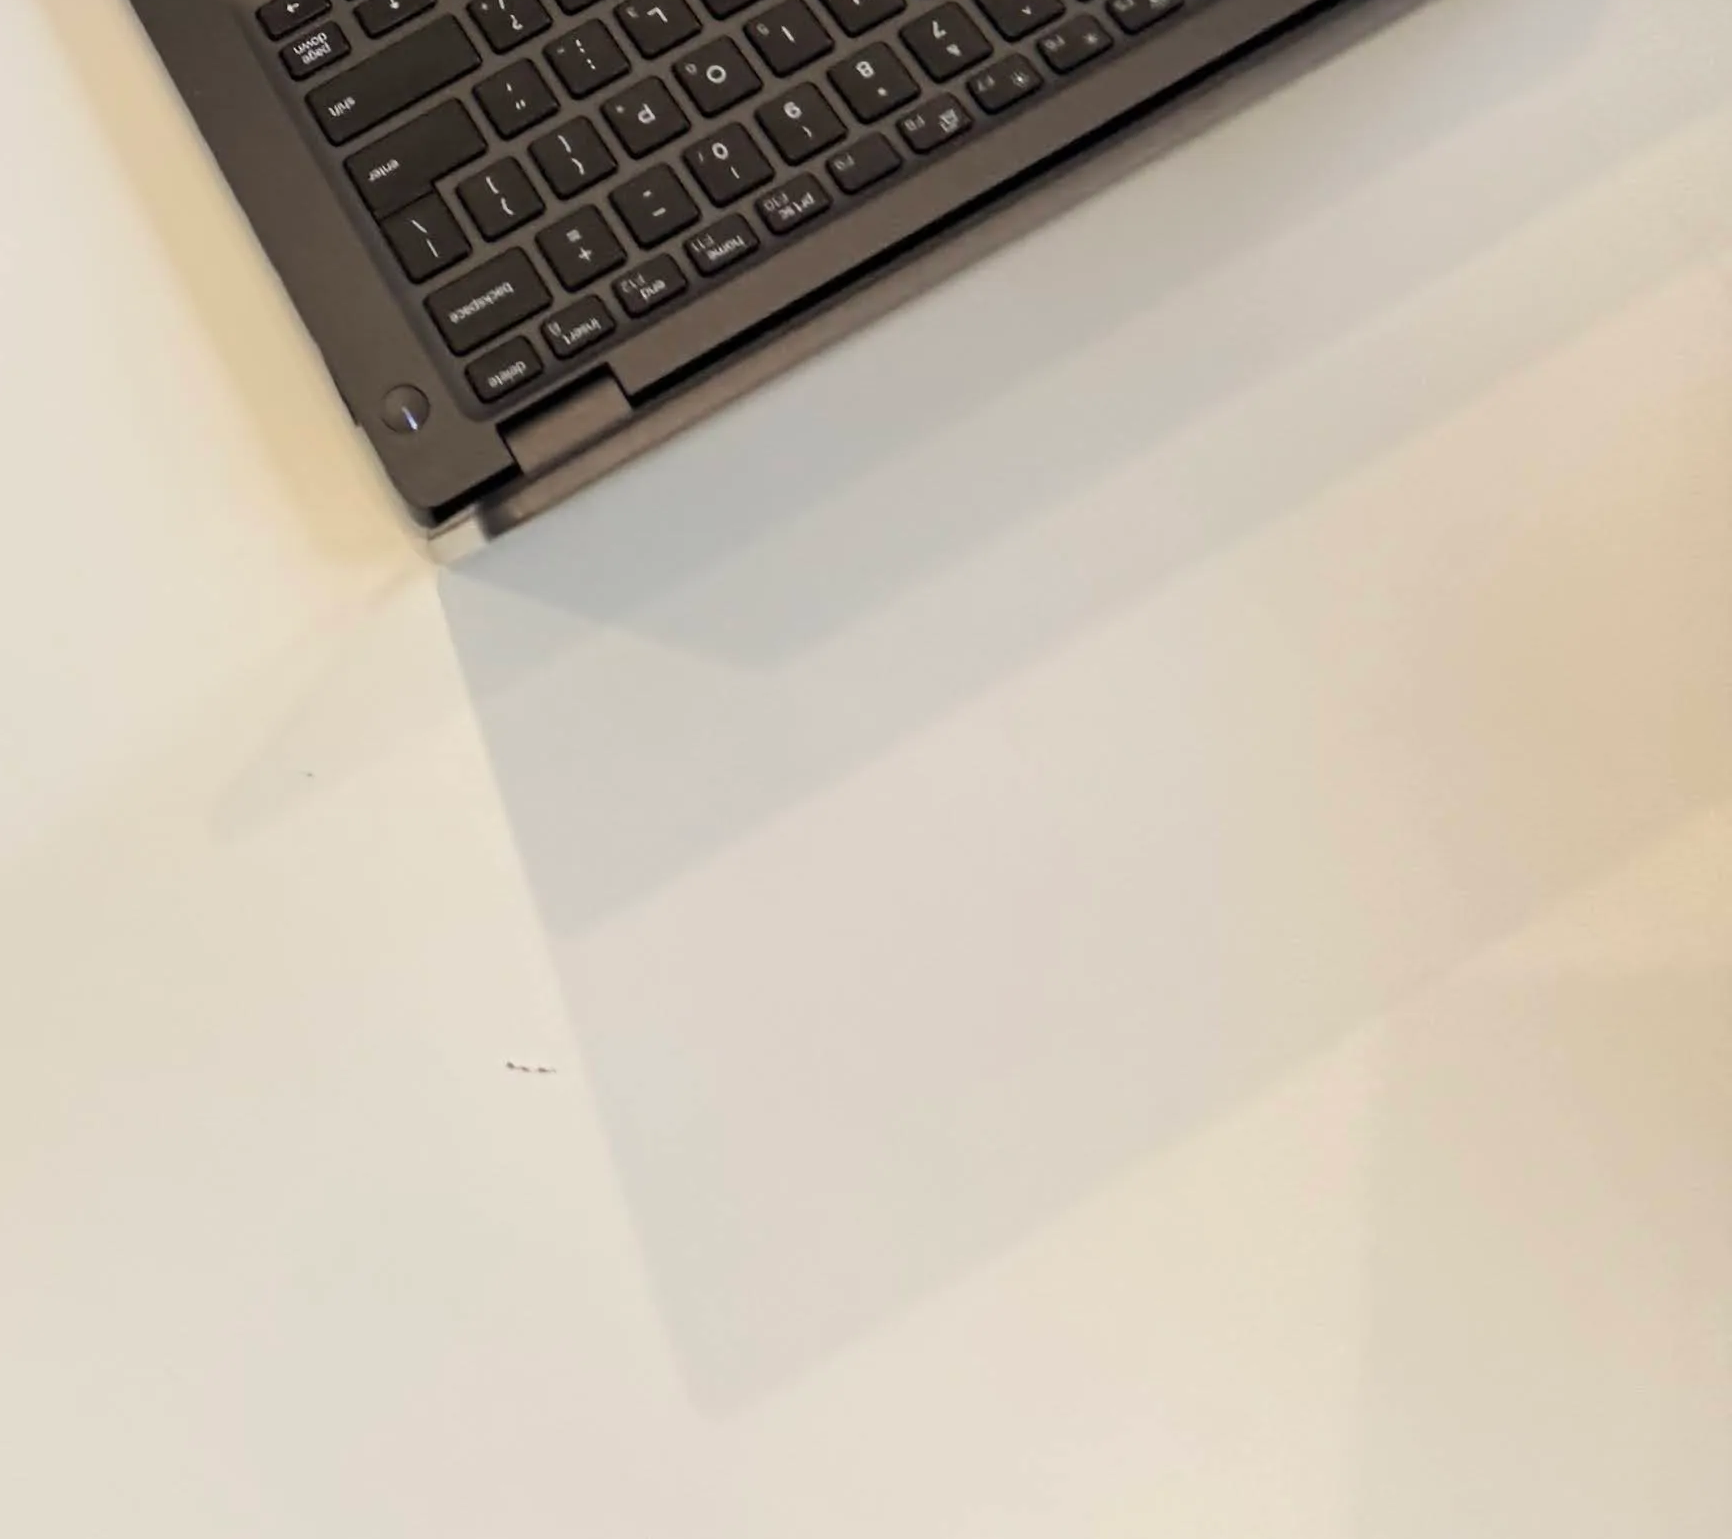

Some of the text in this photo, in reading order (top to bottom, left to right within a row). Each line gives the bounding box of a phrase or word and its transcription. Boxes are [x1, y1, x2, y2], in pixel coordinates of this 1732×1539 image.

[646, 6, 668, 23] L
[780, 25, 795, 42] I
[931, 19, 947, 39] 7
[292, 31, 328, 55] down
[301, 40, 332, 64] page
[705, 63, 727, 84] O
[854, 60, 874, 78] 8
[327, 96, 356, 117] shift
[636, 102, 656, 124] P
[783, 100, 802, 119] 9
[368, 158, 399, 181] enter
[762, 191, 789, 211] F10
[706, 234, 745, 260] home
[638, 279, 666, 300] end
[448, 281, 514, 323] backspace
[561, 317, 602, 345] insert
[487, 360, 527, 388] delete
